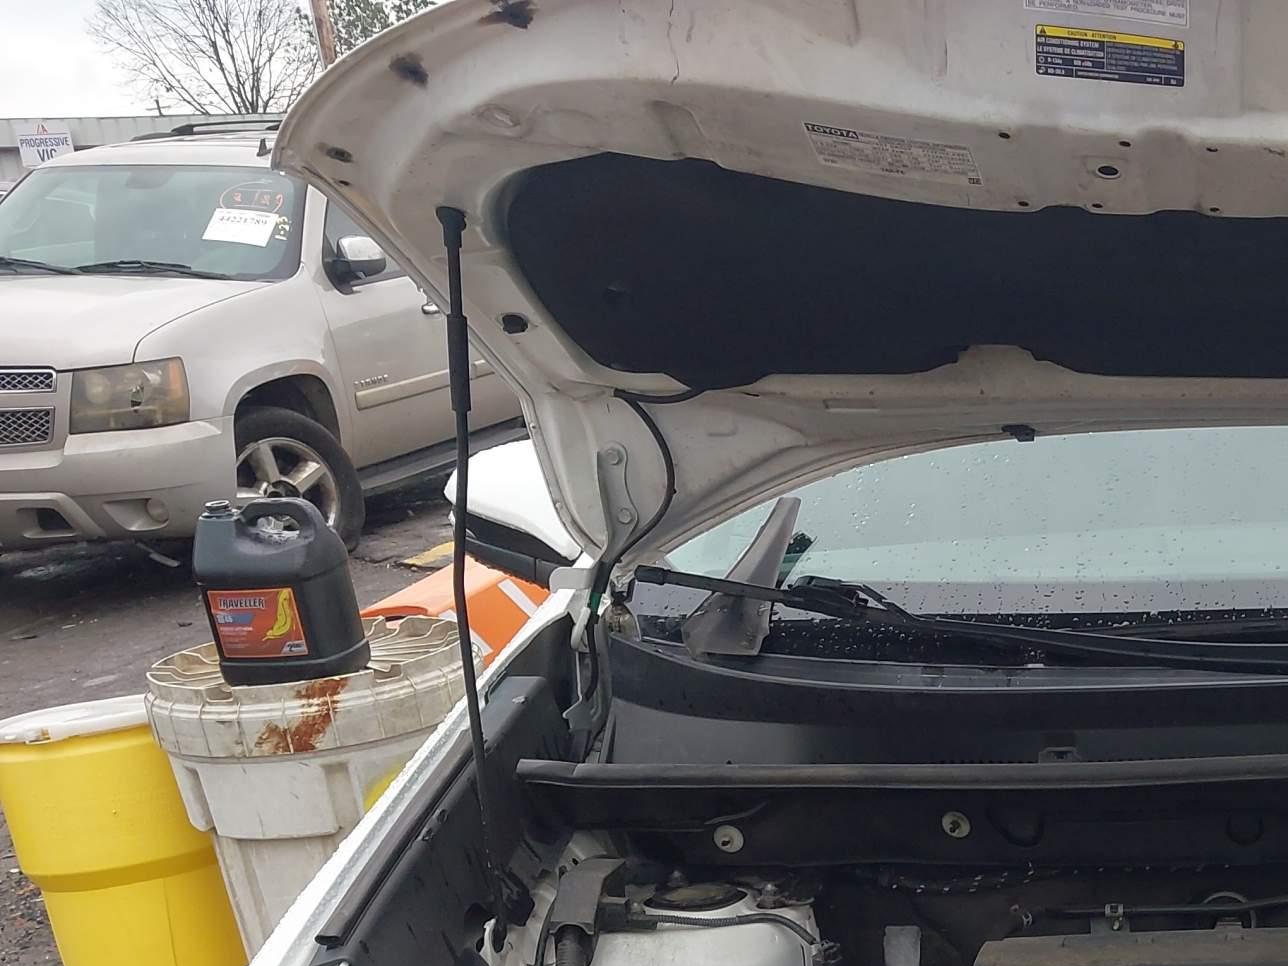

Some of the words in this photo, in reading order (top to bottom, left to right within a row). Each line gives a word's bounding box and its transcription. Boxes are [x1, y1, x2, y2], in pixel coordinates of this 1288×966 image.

[807, 124, 858, 139] TOYOTA
[19, 137, 70, 148] PROGRESSIVE
[219, 597, 265, 609] TRAVELLER
